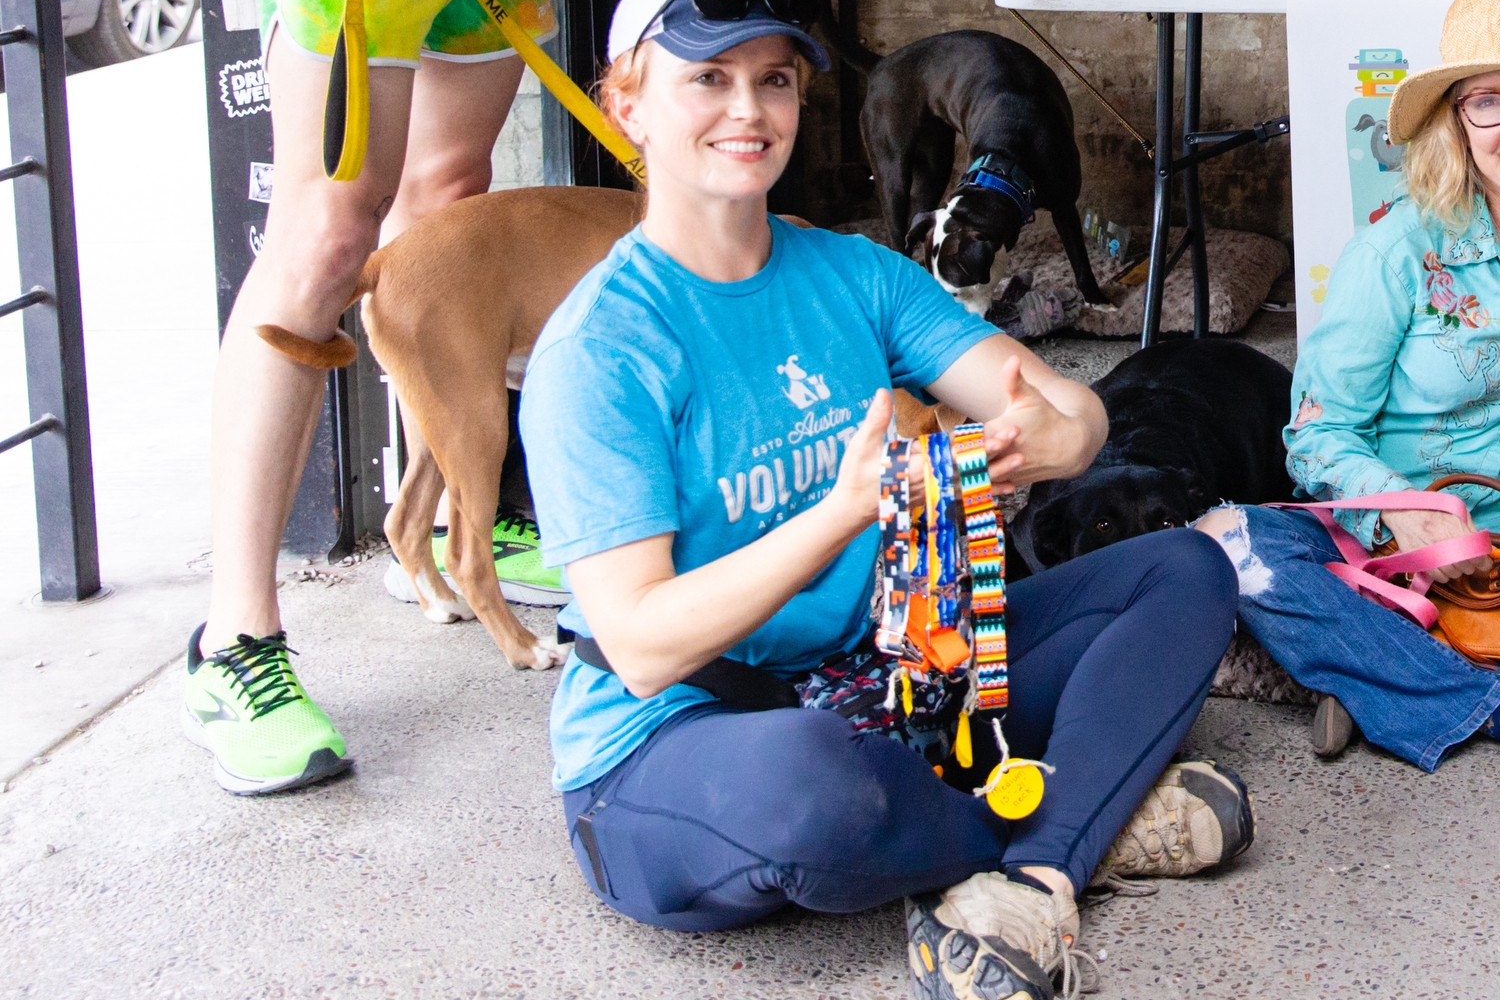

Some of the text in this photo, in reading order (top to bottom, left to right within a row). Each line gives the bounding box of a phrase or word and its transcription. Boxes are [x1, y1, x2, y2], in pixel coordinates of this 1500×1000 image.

[752, 437, 783, 458] ESTD
[787, 406, 852, 445] Austin
[717, 425, 875, 524] VOLUNT
[991, 770, 1026, 797] Medium
[1013, 786, 1034, 807] neck
